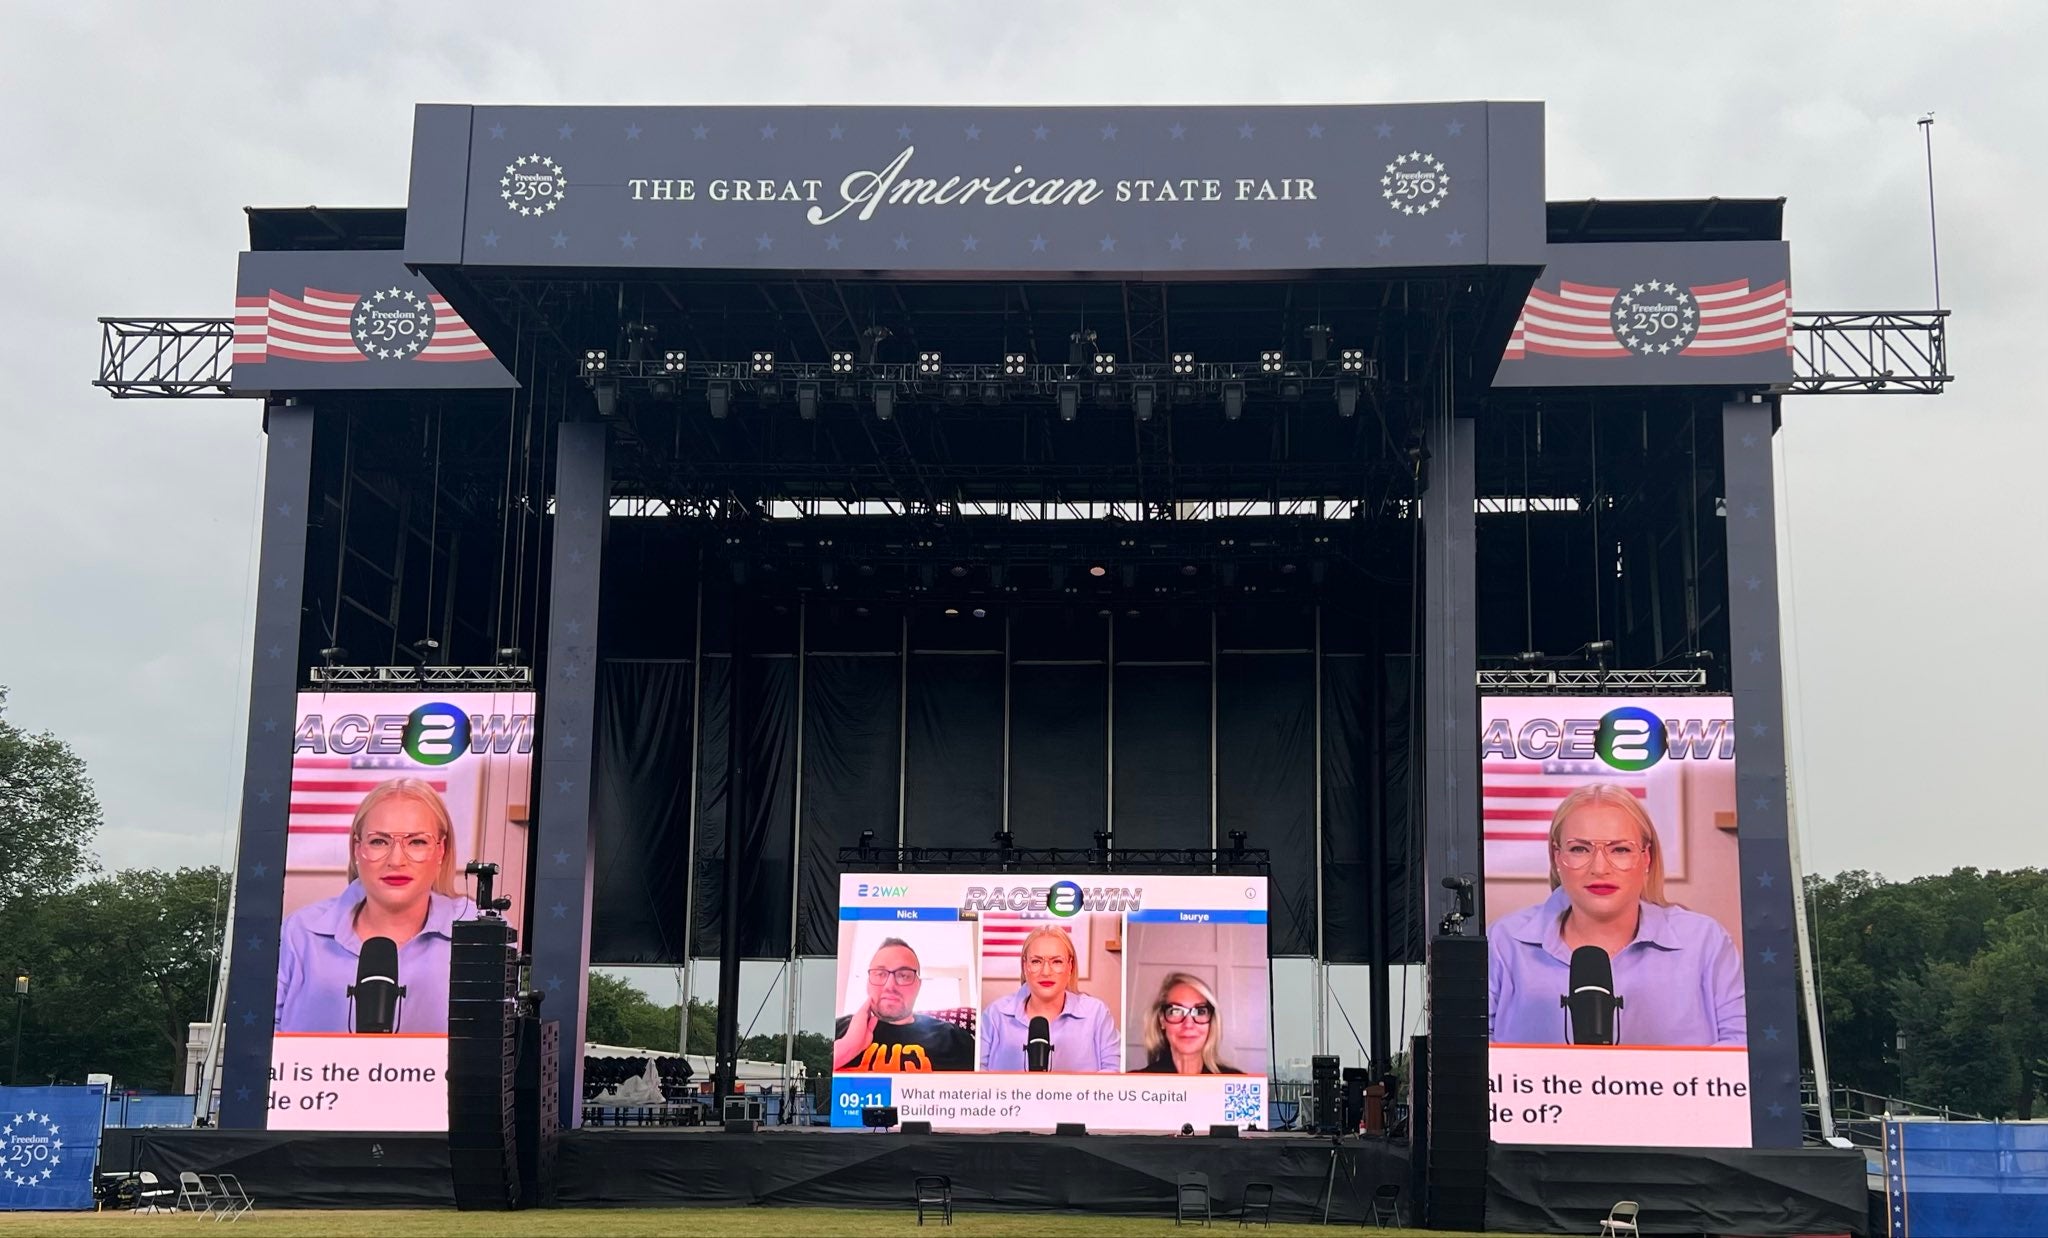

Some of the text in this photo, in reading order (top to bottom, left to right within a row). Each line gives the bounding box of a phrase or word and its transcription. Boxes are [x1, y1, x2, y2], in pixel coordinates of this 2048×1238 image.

[514, 173, 553, 181] Freedom
[1395, 171, 1435, 180] Freedom
[514, 181, 553, 201] 250
[628, 145, 1318, 225] THE GREAT American STATE FAIR
[1395, 179, 1436, 200] 250
[371, 310, 415, 319] Freedom
[1631, 303, 1678, 313] Freedom
[371, 319, 415, 341] 250
[1632, 312, 1679, 335] 250
[872, 886, 908, 897] 2WAY
[896, 910, 918, 919] Nick
[293, 1062, 313, 1081] is
[322, 1062, 360, 1082] the
[368, 1063, 436, 1082] dome
[1513, 1073, 1534, 1094] is
[1542, 1074, 1582, 1095] the
[1591, 1075, 1664, 1096] dome
[1672, 1077, 1699, 1097] of
[1706, 1077, 1747, 1097] the
[300, 1091, 339, 1110] of?
[840, 1093, 884, 1108] 09:11
[901, 1088, 1187, 1104] What material is the dome of the US Capital
[901, 1104, 1021, 1119] Building made of?
[1522, 1103, 1563, 1124] of?
[11, 1134, 49, 1144] Freedom
[10, 1144, 48, 1167] 250
